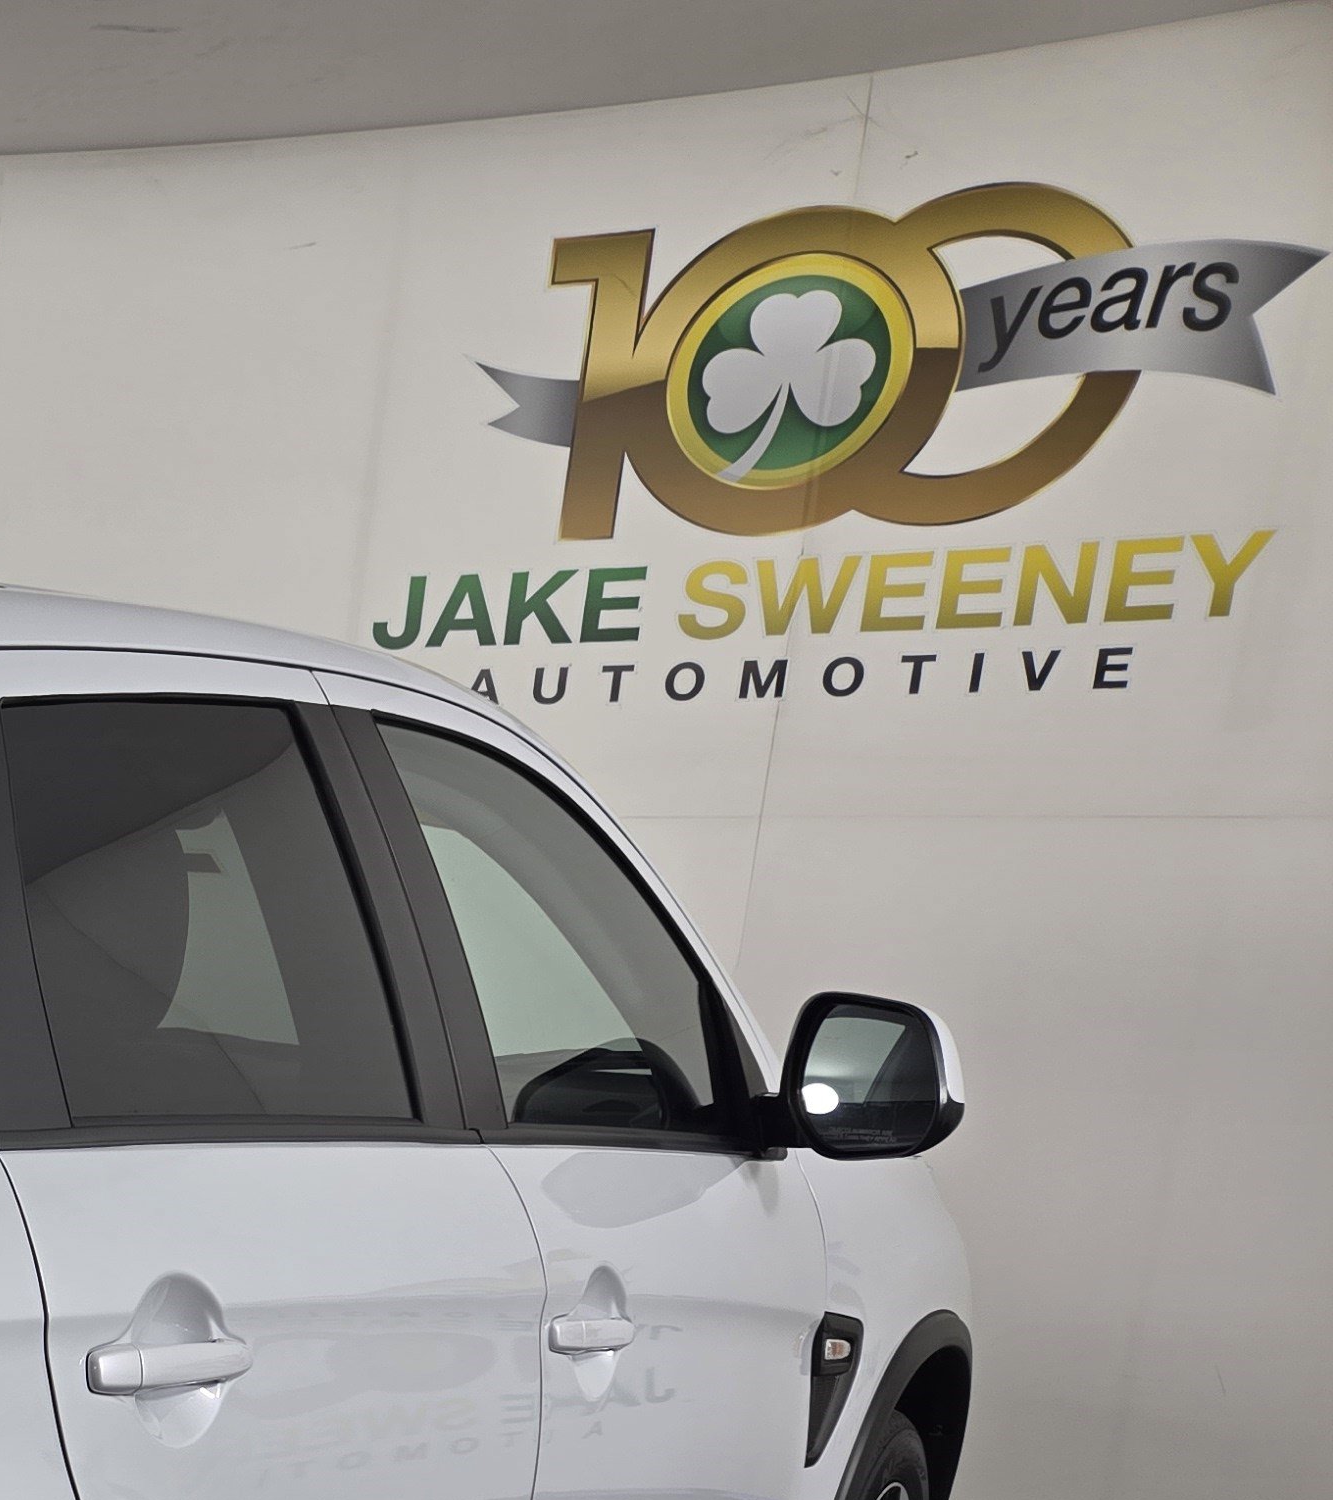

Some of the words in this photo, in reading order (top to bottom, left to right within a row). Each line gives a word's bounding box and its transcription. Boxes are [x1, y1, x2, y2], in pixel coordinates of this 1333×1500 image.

[977, 259, 1239, 373] years
[372, 565, 648, 650] JAKE
[677, 529, 1278, 640] SWEENEY
[471, 646, 1134, 706] AUTOMOTIVE
